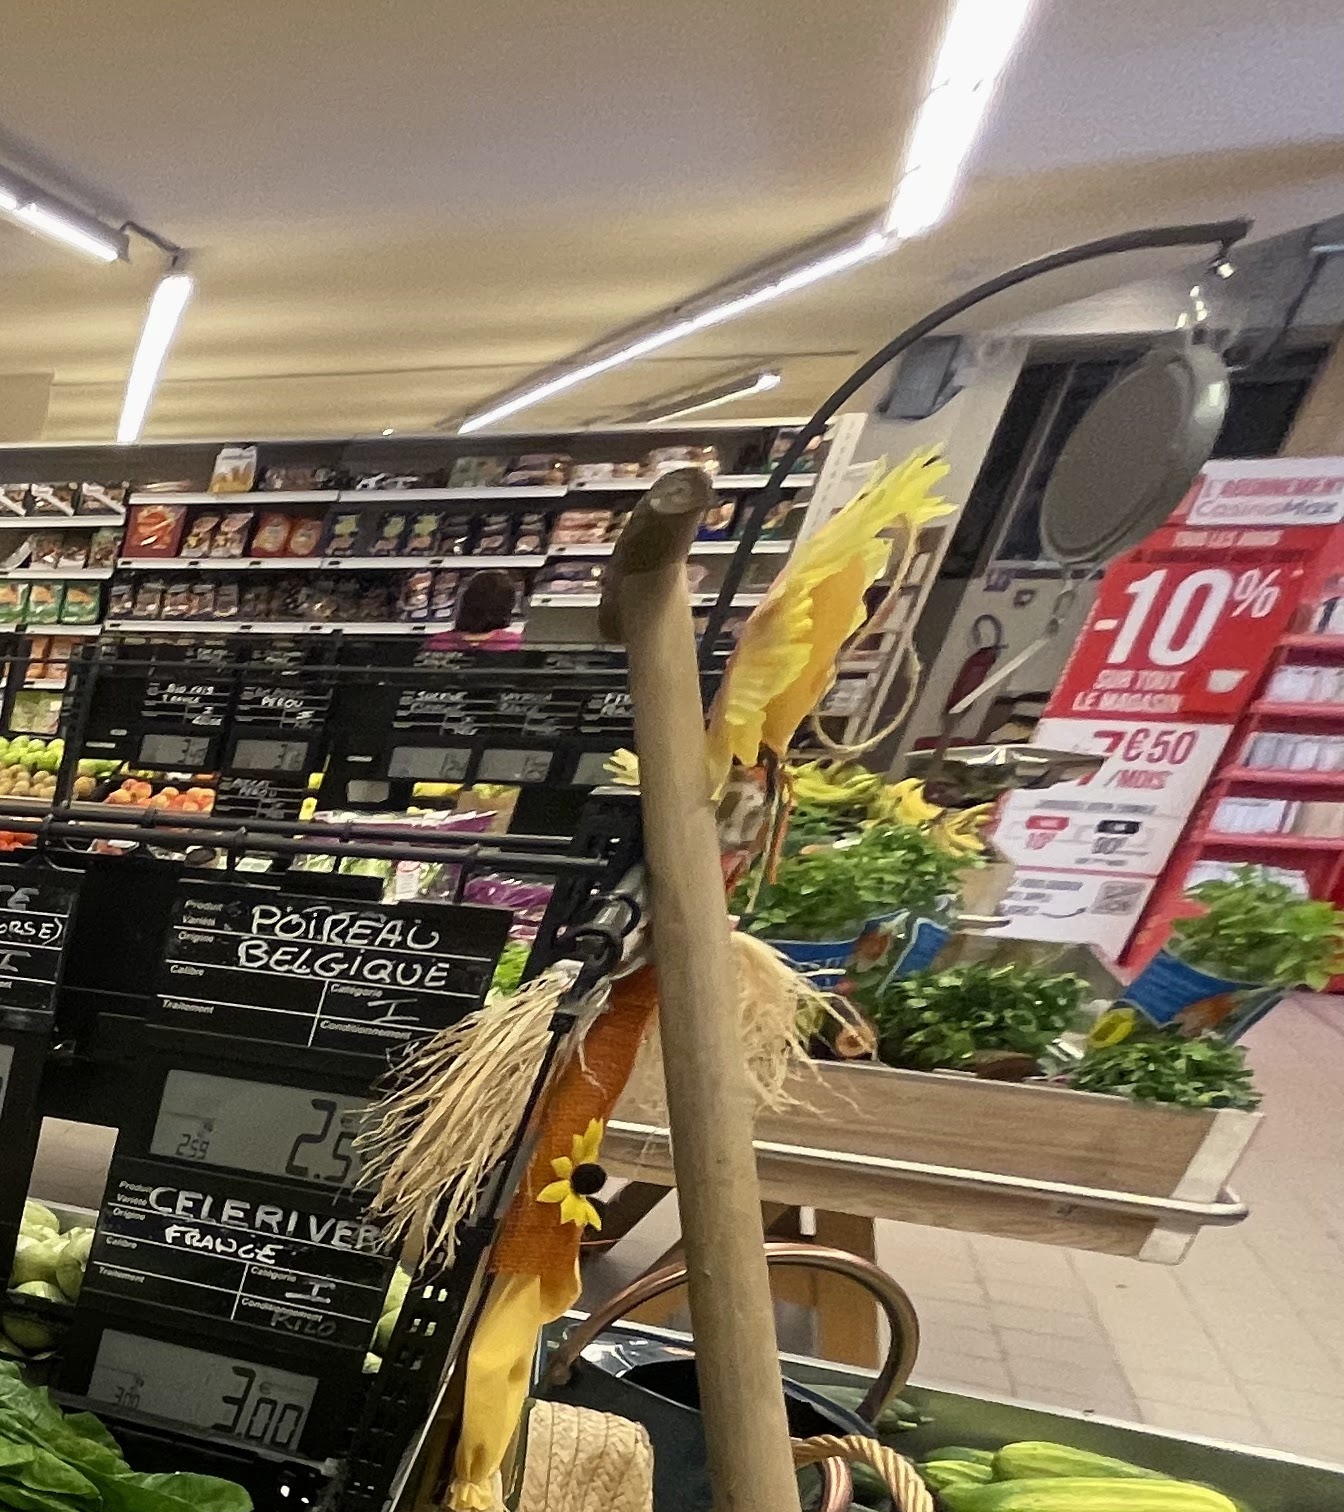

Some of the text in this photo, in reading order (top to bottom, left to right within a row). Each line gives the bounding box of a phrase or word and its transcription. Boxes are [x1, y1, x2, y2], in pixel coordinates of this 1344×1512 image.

[251, 904, 440, 950] POIREAU
[237, 939, 451, 987] BELGIQUE
[148, 1186, 300, 1237] CELERI
[164, 1223, 284, 1265] FRANCE
[210, 1365, 304, 1447] 3.00
